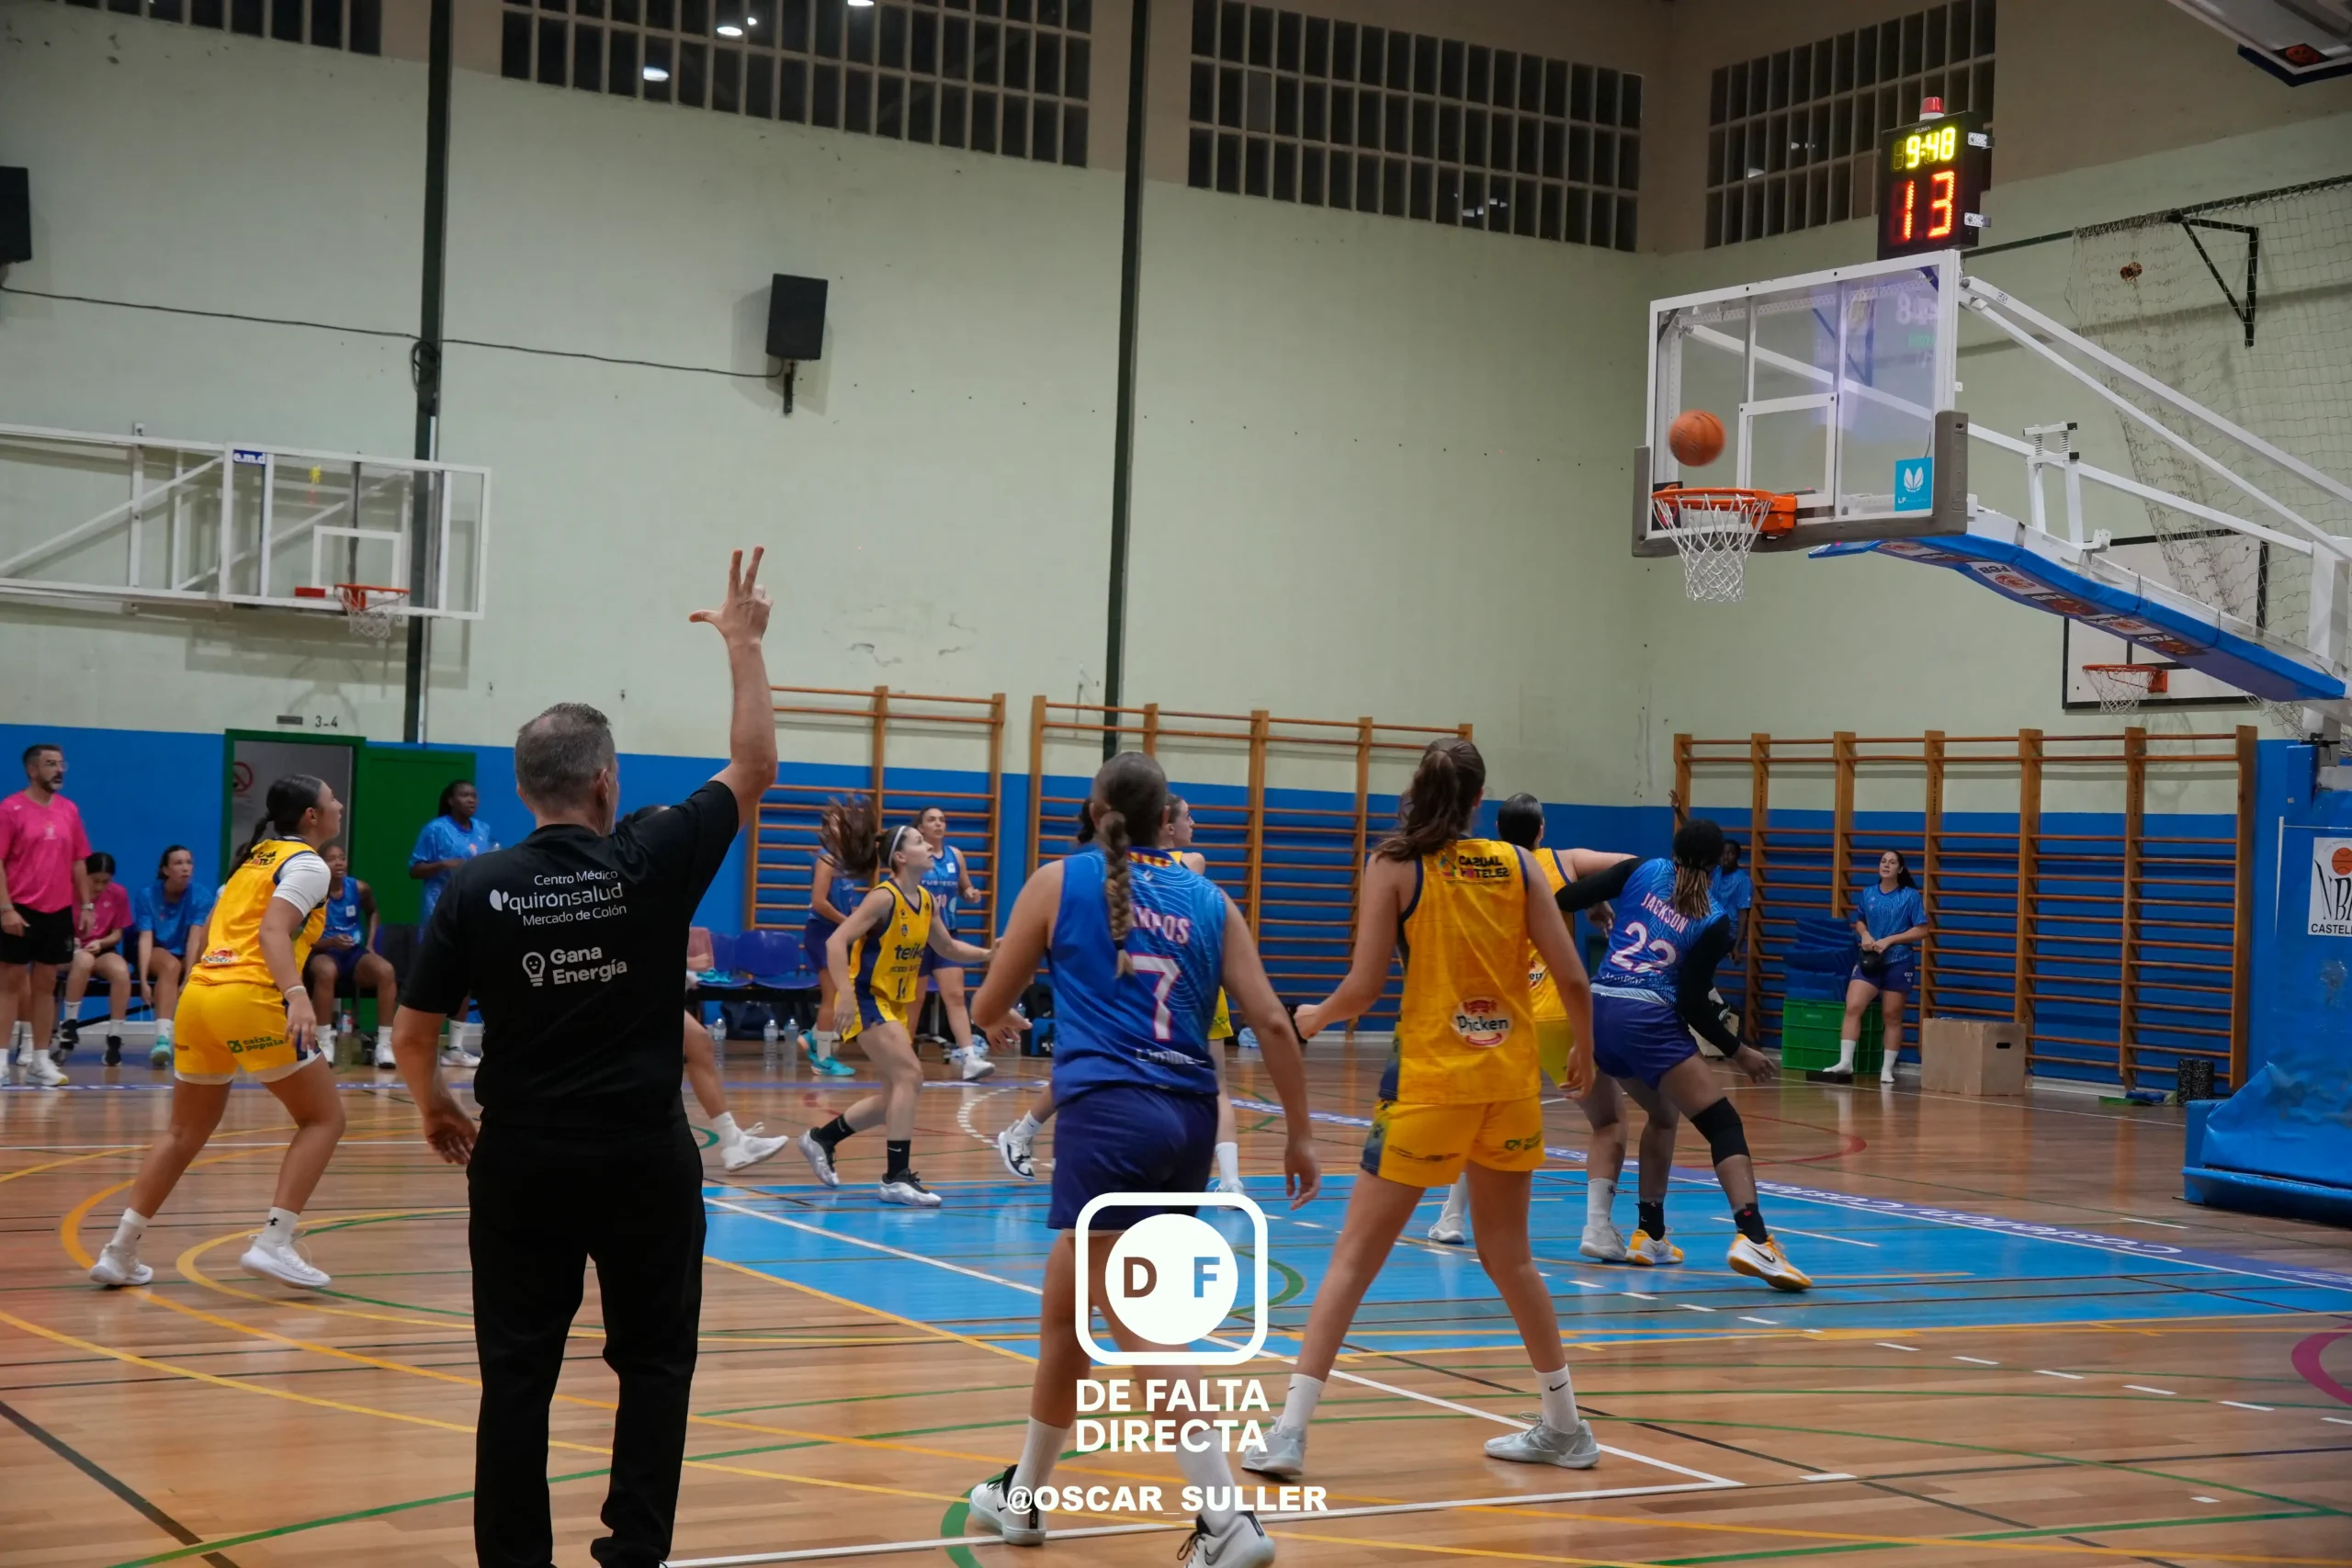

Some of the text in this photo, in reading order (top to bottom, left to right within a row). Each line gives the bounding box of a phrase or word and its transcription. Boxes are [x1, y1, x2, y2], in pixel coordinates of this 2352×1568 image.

[1905, 126, 1956, 169] 9:48
[1905, 170, 1955, 240] 13
[1459, 855, 1504, 867] CASUAL
[534, 870, 618, 886] Centro Médico
[509, 883, 624, 915] quirónsalud
[1640, 892, 1689, 934] JACKSON
[523, 905, 628, 926] Mercado de Colón
[549, 946, 603, 964] Gana
[1610, 921, 1678, 975] 22
[552, 959, 628, 985] Energía
[1130, 953, 1182, 1042] 7
[1456, 1015, 1509, 1032] Picken
